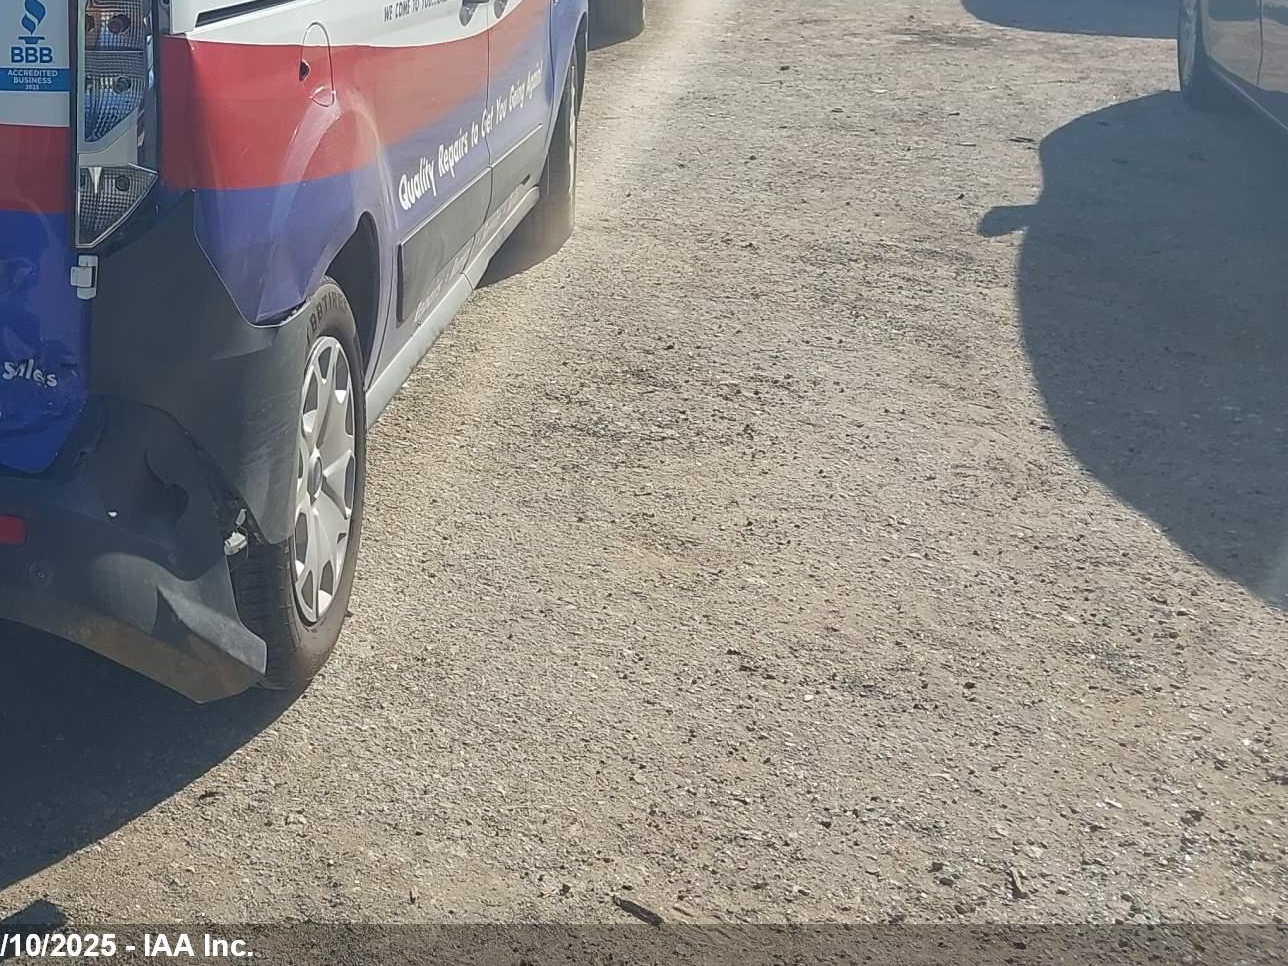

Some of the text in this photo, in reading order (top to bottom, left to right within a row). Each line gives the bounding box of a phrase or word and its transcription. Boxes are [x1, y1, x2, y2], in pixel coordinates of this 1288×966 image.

[11, 46, 53, 63] BBB
[7, 69, 58, 77] ACCREDITED
[13, 76, 52, 84] BUSINESS
[398, 156, 437, 210] Quality
[438, 129, 469, 178] Repairs
[471, 121, 479, 148] to
